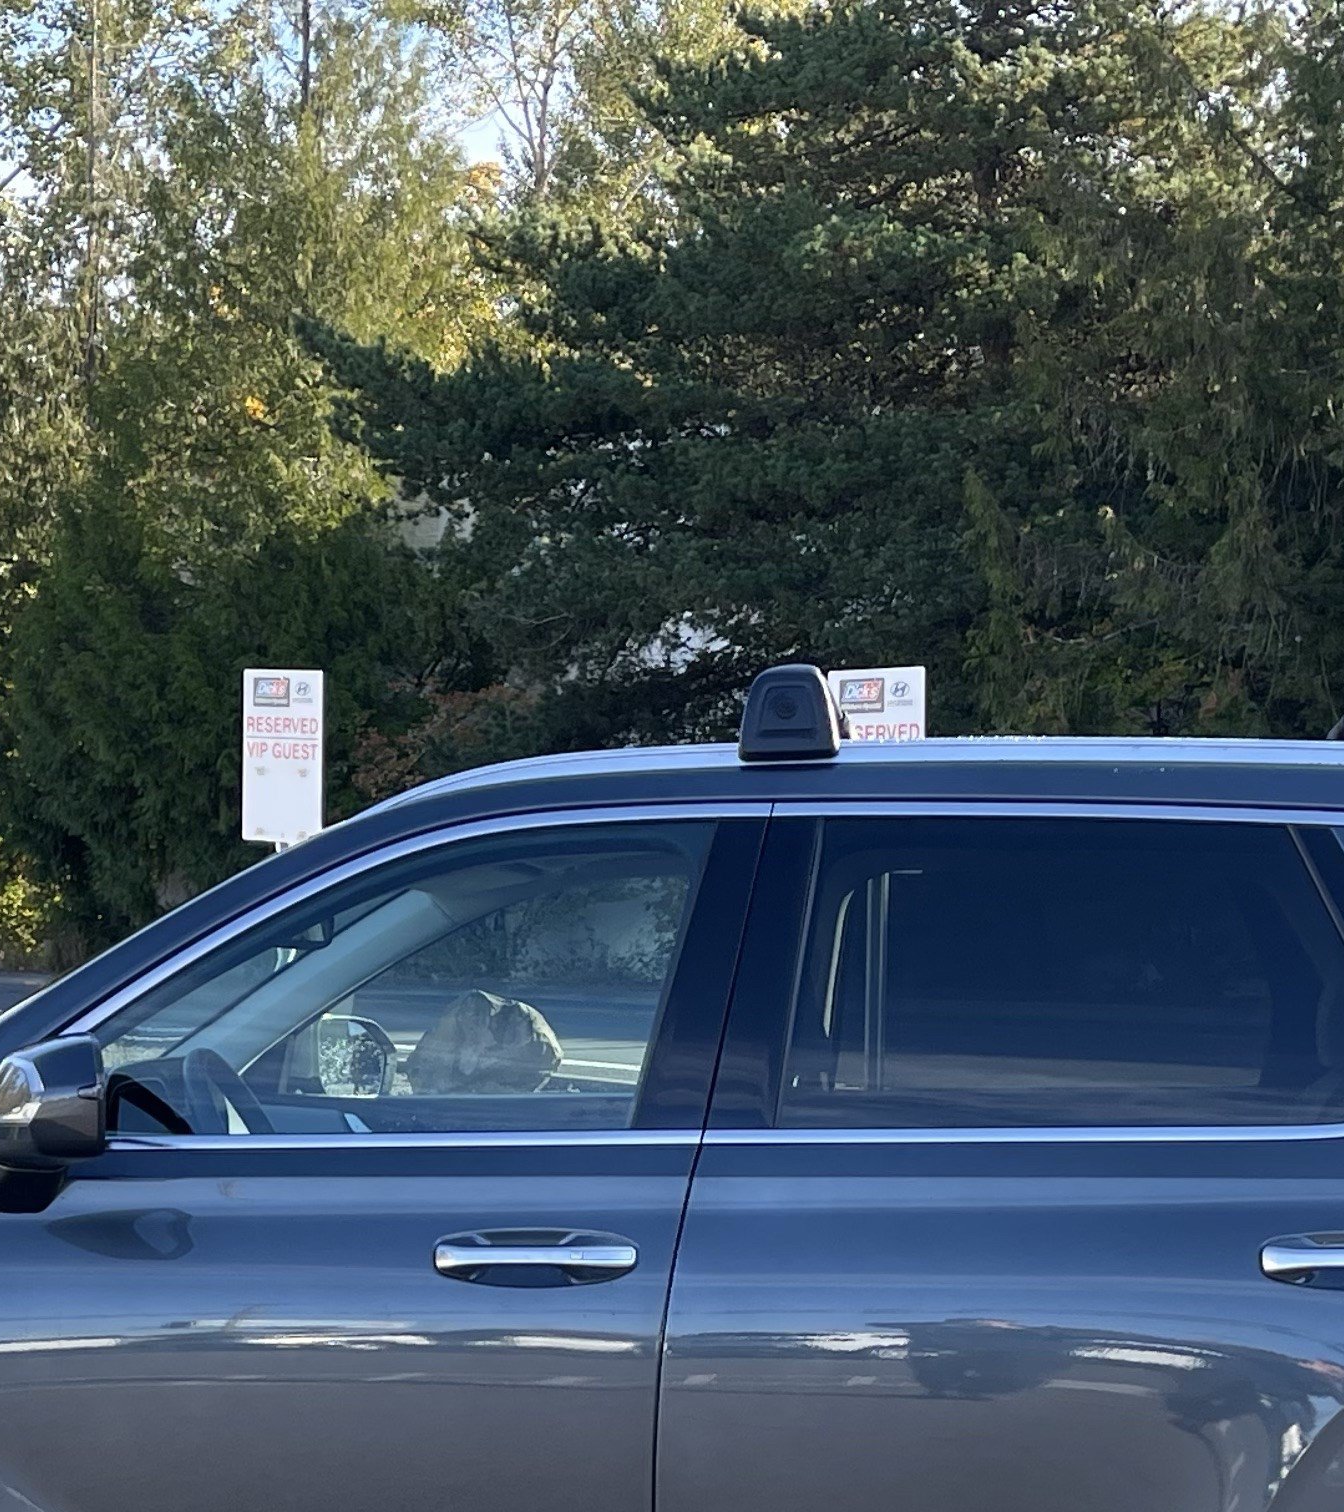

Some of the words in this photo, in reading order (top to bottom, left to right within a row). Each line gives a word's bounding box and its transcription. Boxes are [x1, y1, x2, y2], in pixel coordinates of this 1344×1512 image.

[246, 716, 319, 734] RESERVED
[247, 741, 268, 758] VIP
[272, 743, 319, 761] GUEST
